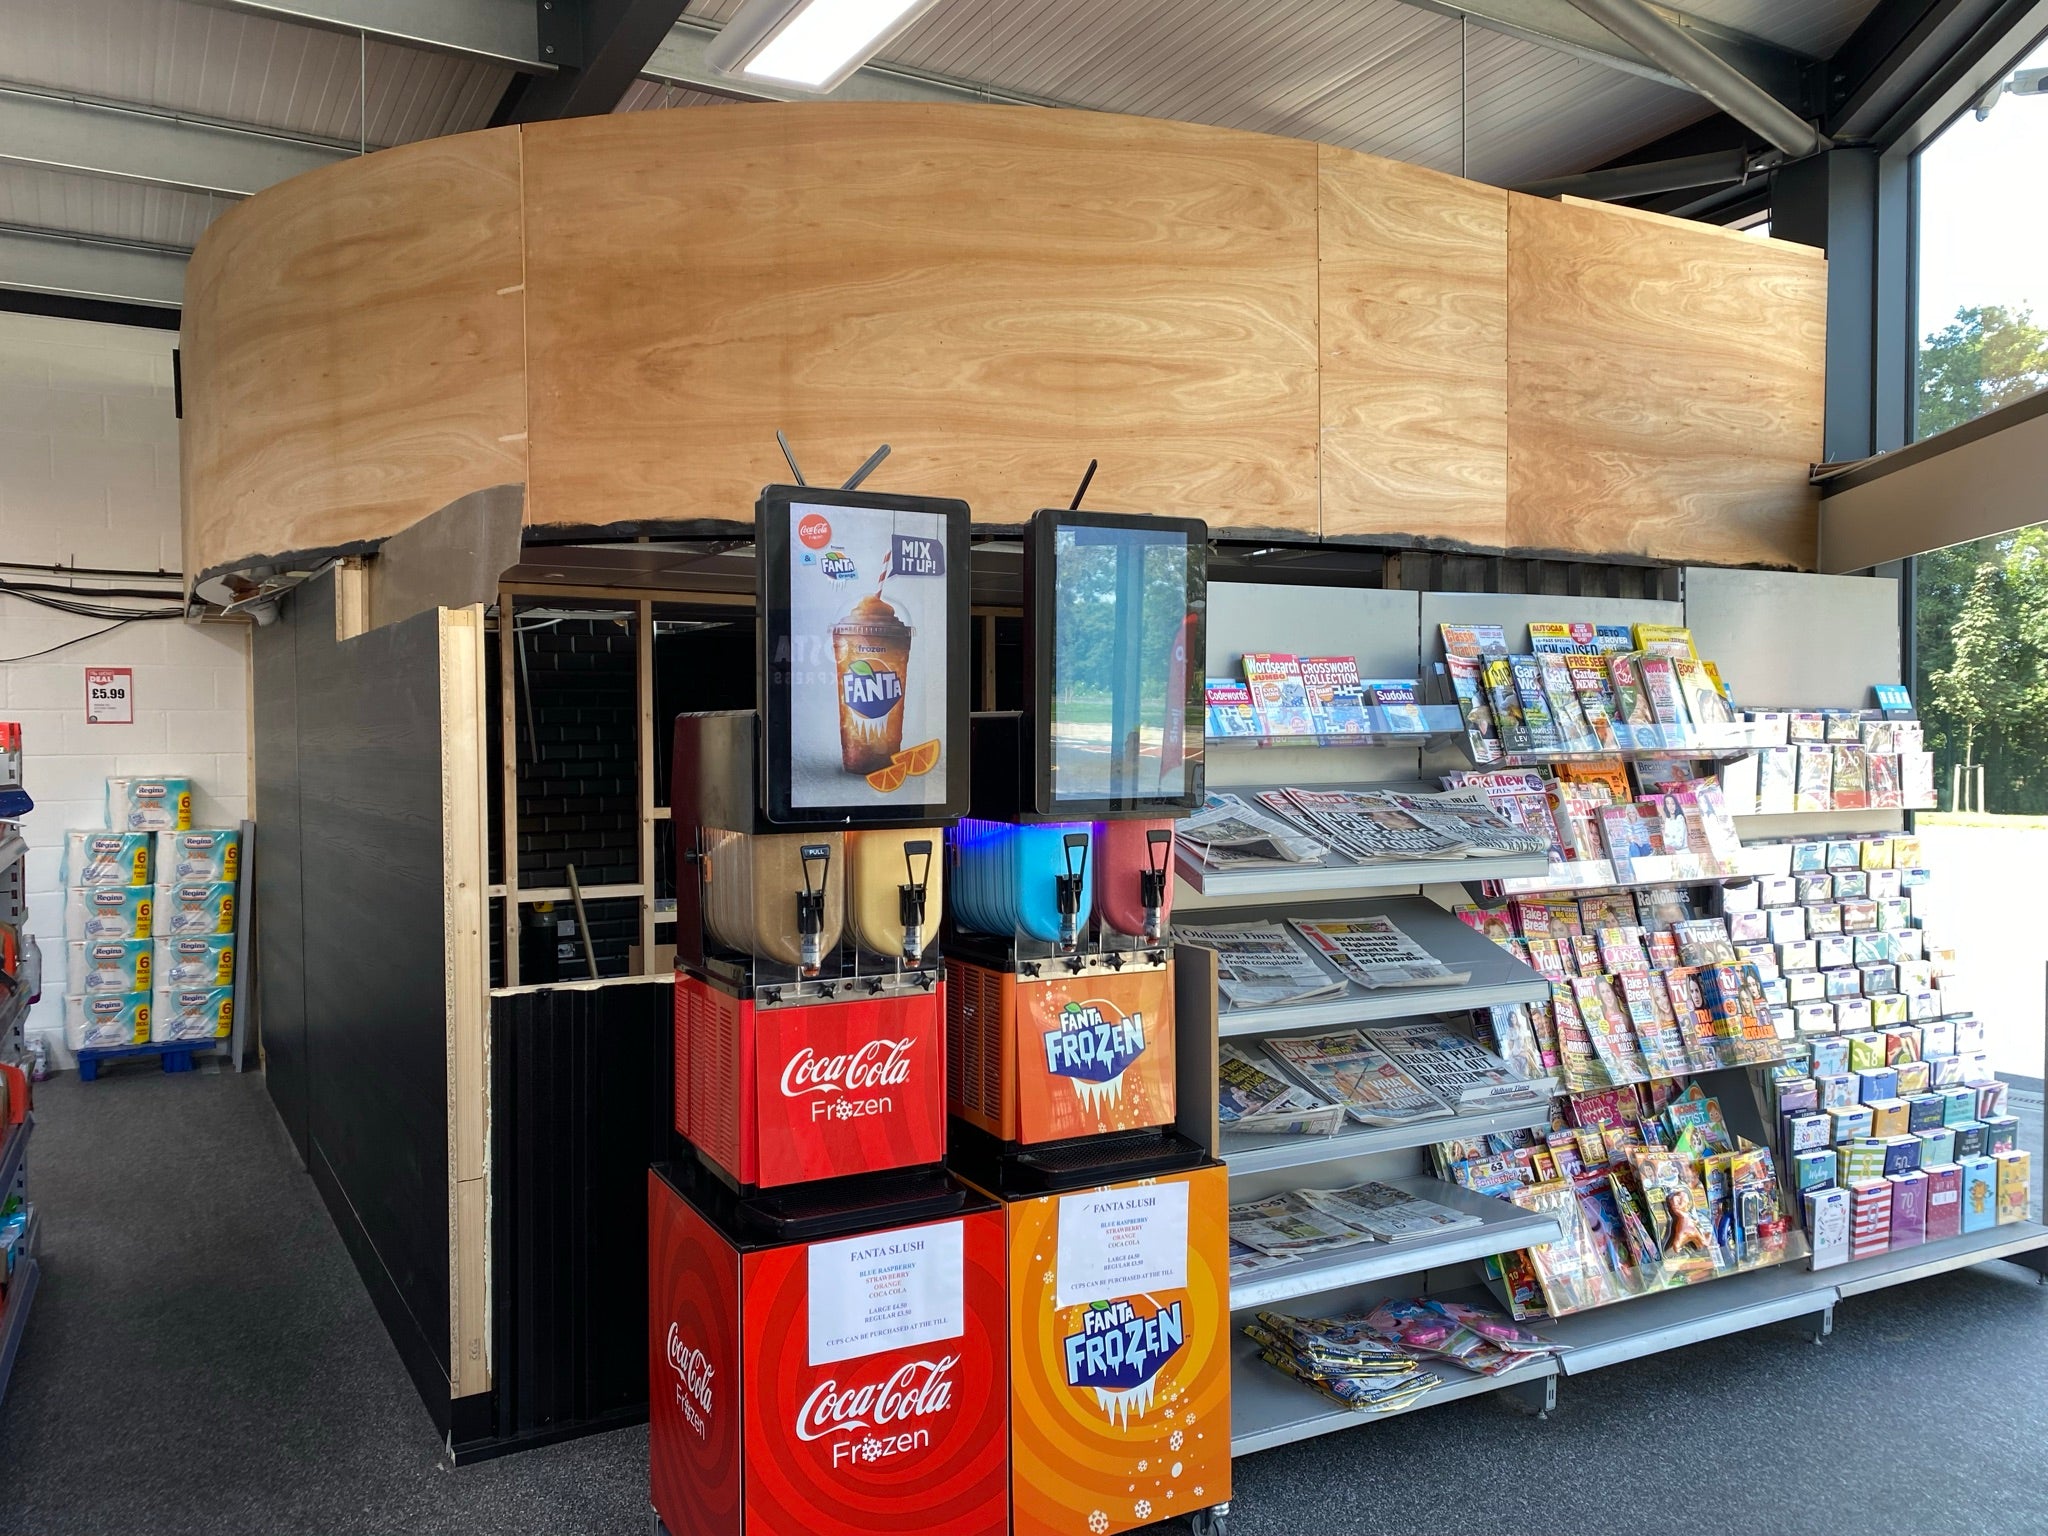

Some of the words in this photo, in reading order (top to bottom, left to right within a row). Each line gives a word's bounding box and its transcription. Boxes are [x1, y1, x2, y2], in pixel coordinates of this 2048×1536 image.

[902, 540, 931, 559] MIX
[822, 557, 854, 573] FANTA
[902, 558, 914, 571] IT
[916, 560, 936, 574] UP!
[858, 644, 886, 653] frozen
[1535, 644, 1558, 653] NEW
[1572, 644, 1599, 655] USED
[1248, 659, 1300, 674] Wordsearch
[1301, 662, 1356, 674] CROSSWORD
[1252, 673, 1286, 681] JUMBO
[1304, 673, 1359, 685] COLLECTION
[843, 673, 902, 703] FANTA
[1575, 680, 1599, 689] NEWS
[92, 688, 125, 699] £5.99
[1208, 690, 1248, 701] Codewords
[1378, 691, 1413, 701] Sudoku
[1469, 777, 1493, 787] OK!
[139, 787, 164, 795] Regina
[182, 796, 190, 808] 6
[1451, 795, 1478, 803] Mail
[137, 852, 146, 863] 6
[228, 848, 237, 859] 6
[97, 894, 123, 902] Regina
[140, 904, 150, 915] 6
[223, 900, 232, 911] 6
[1583, 900, 1608, 911] that's
[1521, 906, 1543, 919] Take
[1543, 910, 1549, 919] a
[1583, 909, 1601, 920] life!
[1524, 920, 1549, 932] Break
[1674, 920, 1688, 929] Total
[1182, 930, 1239, 940] Oldham
[1243, 932, 1283, 940] Times
[96, 948, 122, 956] Regina
[180, 942, 206, 950] Regina
[140, 957, 150, 968] 6
[222, 952, 232, 963] 6
[1604, 950, 1643, 963] Closer
[1625, 976, 1643, 990] Take
[1643, 979, 1648, 987] a
[1628, 989, 1650, 1002] Break
[138, 1009, 148, 1020] 6
[222, 1003, 231, 1014] 6
[1555, 1002, 1573, 1017] Real
[1060, 1007, 1103, 1032] FANTA
[1406, 1025, 1450, 1036] EXPRESS
[1045, 1012, 1145, 1073] FROZEN
[1396, 1050, 1450, 1064] URGENT
[1450, 1045, 1488, 1060] PLEA
[781, 1036, 918, 1097] Coca-Cola
[1407, 1063, 1430, 1076] TO
[1430, 1060, 1465, 1074] ROLL
[1464, 1057, 1494, 1070] OUT
[1368, 1076, 1405, 1090] WHAT
[1420, 1071, 1480, 1086] BOOSTER
[811, 1096, 892, 1122] Frozen
[1581, 1109, 1613, 1124] NOMS
[1491, 1163, 1503, 1171] 63
[1475, 1170, 1518, 1186] Fantastic!
[1093, 1202, 1125, 1213] FANTA
[1126, 1197, 1156, 1209] SLUSH
[1250, 1198, 1287, 1209] POST
[1901, 1192, 1914, 1210] 70
[1100, 1220, 1116, 1229] BLUE
[1116, 1216, 1148, 1226] RASPBERRY
[1105, 1224, 1143, 1235] STRAWBERRY
[1112, 1232, 1136, 1241] ORANGE
[850, 1247, 886, 1262] FANTA
[888, 1240, 925, 1255] SLUSH
[1108, 1241, 1124, 1249] COCA
[1107, 1254, 1126, 1263] LARGE
[859, 1268, 877, 1277] BLUE
[878, 1262, 916, 1274] RASPBERRY
[1103, 1261, 1131, 1271] REGULAR
[866, 1271, 910, 1284] STRAWBERRY
[1071, 1281, 1086, 1290] CUPS
[1086, 1279, 1099, 1288] CAN
[1099, 1278, 1107, 1286] BE
[1107, 1273, 1141, 1285] PURCHASED
[1162, 1268, 1174, 1276] TILL
[1508, 1271, 1519, 1280] 10
[874, 1280, 902, 1290] ORANGE
[869, 1291, 888, 1299] COCA
[888, 1287, 907, 1296] COLA
[869, 1305, 892, 1315] LARGE
[864, 1312, 896, 1323] REGULAR
[1083, 1302, 1134, 1335] FANTA
[826, 1338, 844, 1347] CUPS
[845, 1335, 859, 1344] CAN
[860, 1332, 869, 1340] BE
[870, 1325, 909, 1338] PURCHASED
[919, 1320, 933, 1328] THE
[933, 1317, 947, 1326] TILL
[1065, 1302, 1183, 1384] FROZEN
[667, 1321, 715, 1414] Coca-Cola
[796, 1353, 961, 1441] Coca-Cola
[833, 1428, 929, 1468] Frozen
